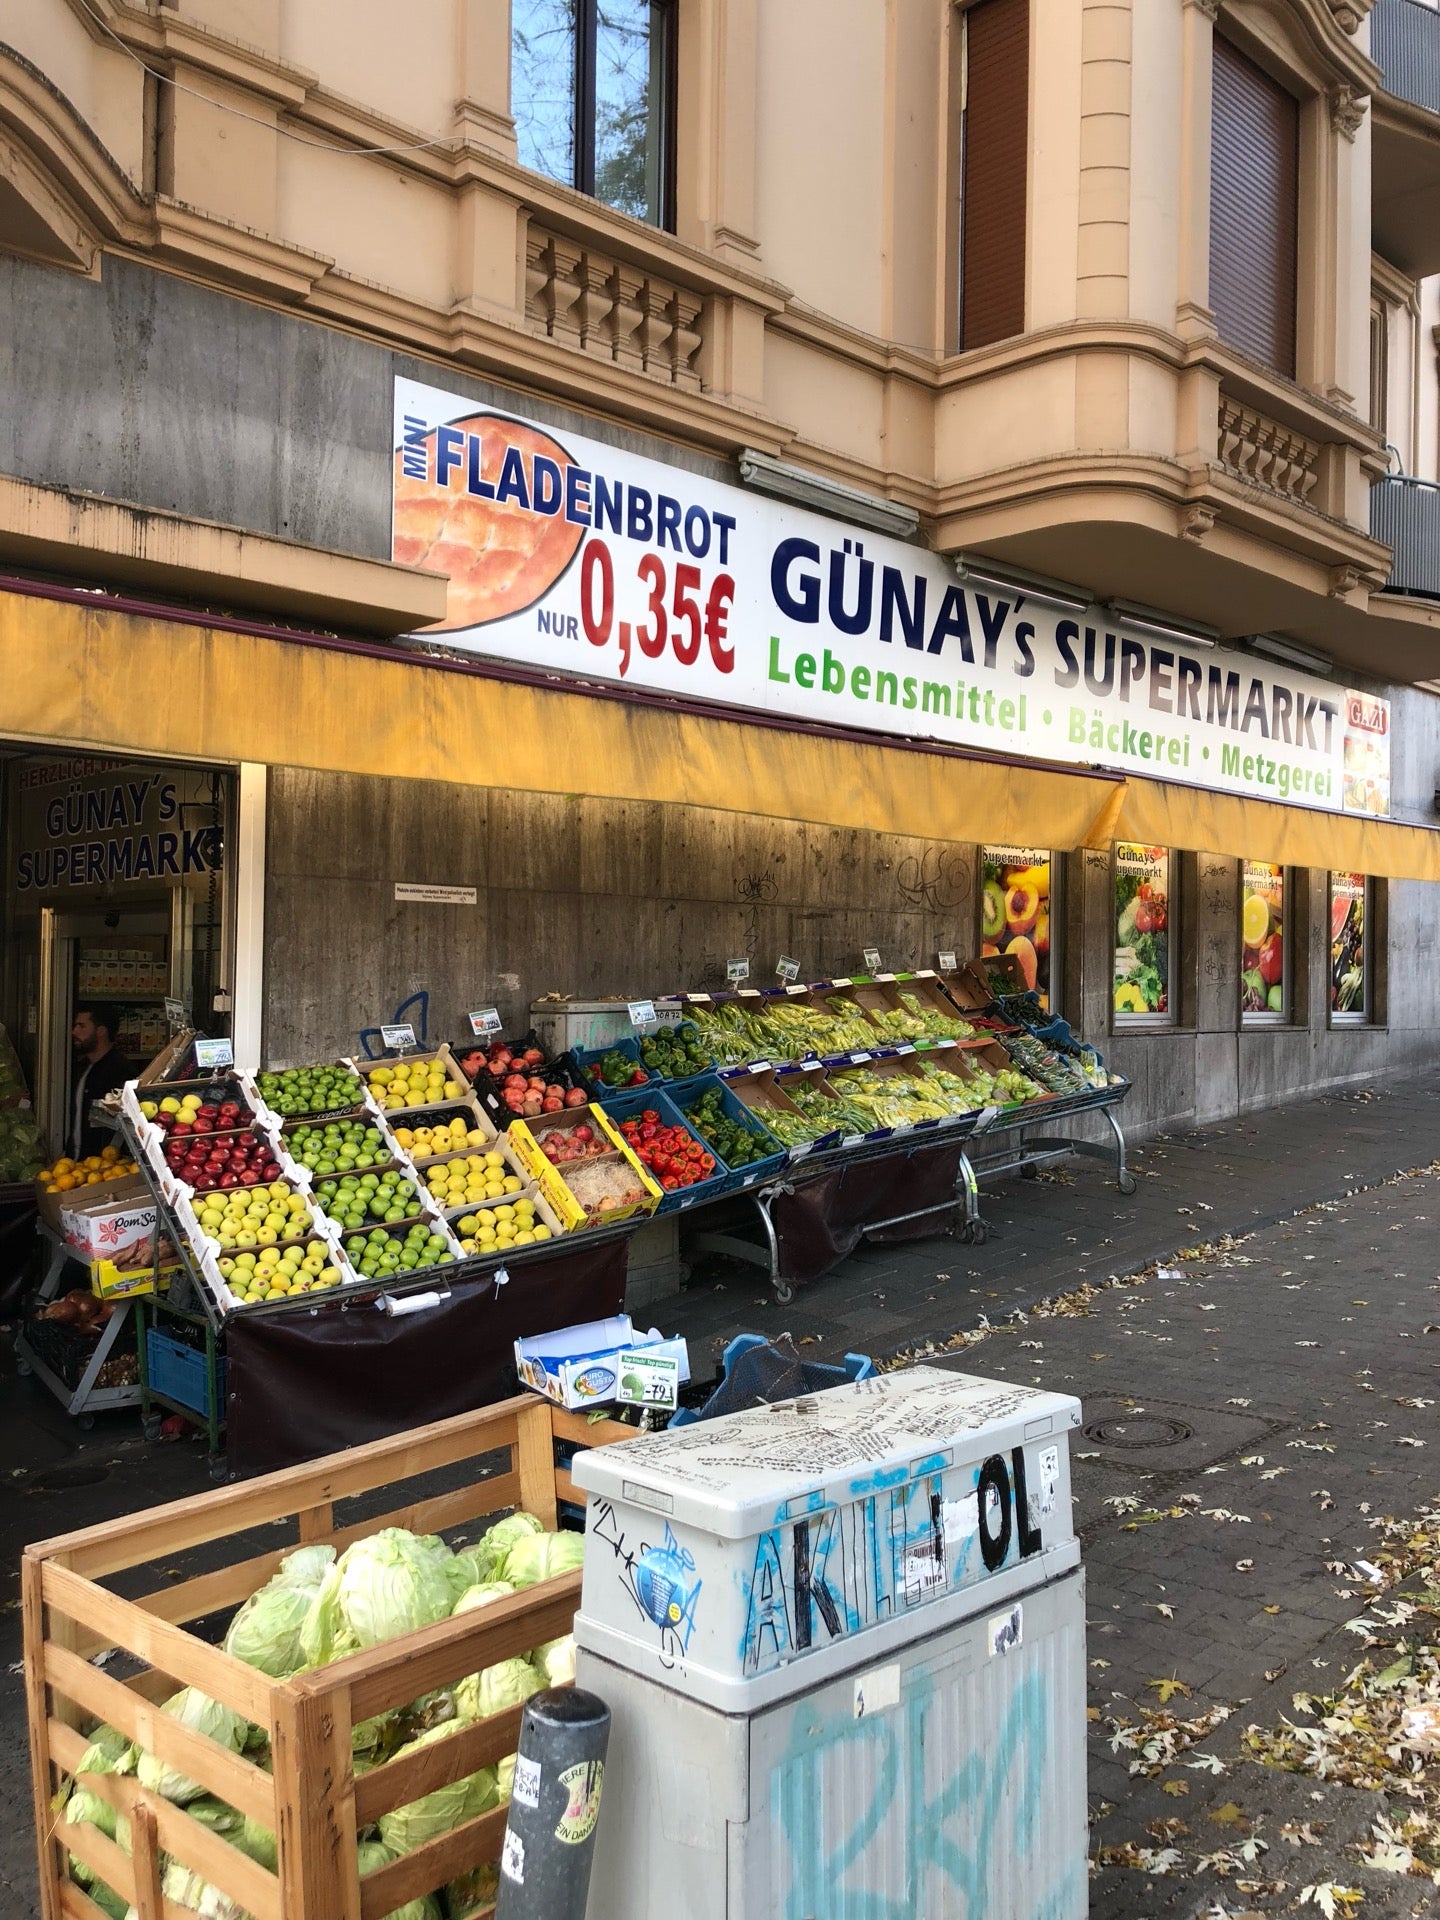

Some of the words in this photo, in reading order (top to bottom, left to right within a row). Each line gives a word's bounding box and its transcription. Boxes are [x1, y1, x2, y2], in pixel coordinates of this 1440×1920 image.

[403, 415, 428, 481] MINI
[436, 425, 737, 566] FLADENBROT
[537, 608, 579, 641] NUR
[580, 538, 736, 678] 0,35€
[768, 636, 1027, 732] Lebensmittel
[1068, 706, 1190, 767] Bäckerei
[1221, 743, 1332, 798] Metzgerei
[1054, 619, 1339, 755] SUPERMARKT
[18, 757, 95, 790] HERZLICH
[1116, 865, 1162, 878] upermarkt
[580, 1371, 604, 1382] PURO
[586, 1375, 615, 1387] GUSTO
